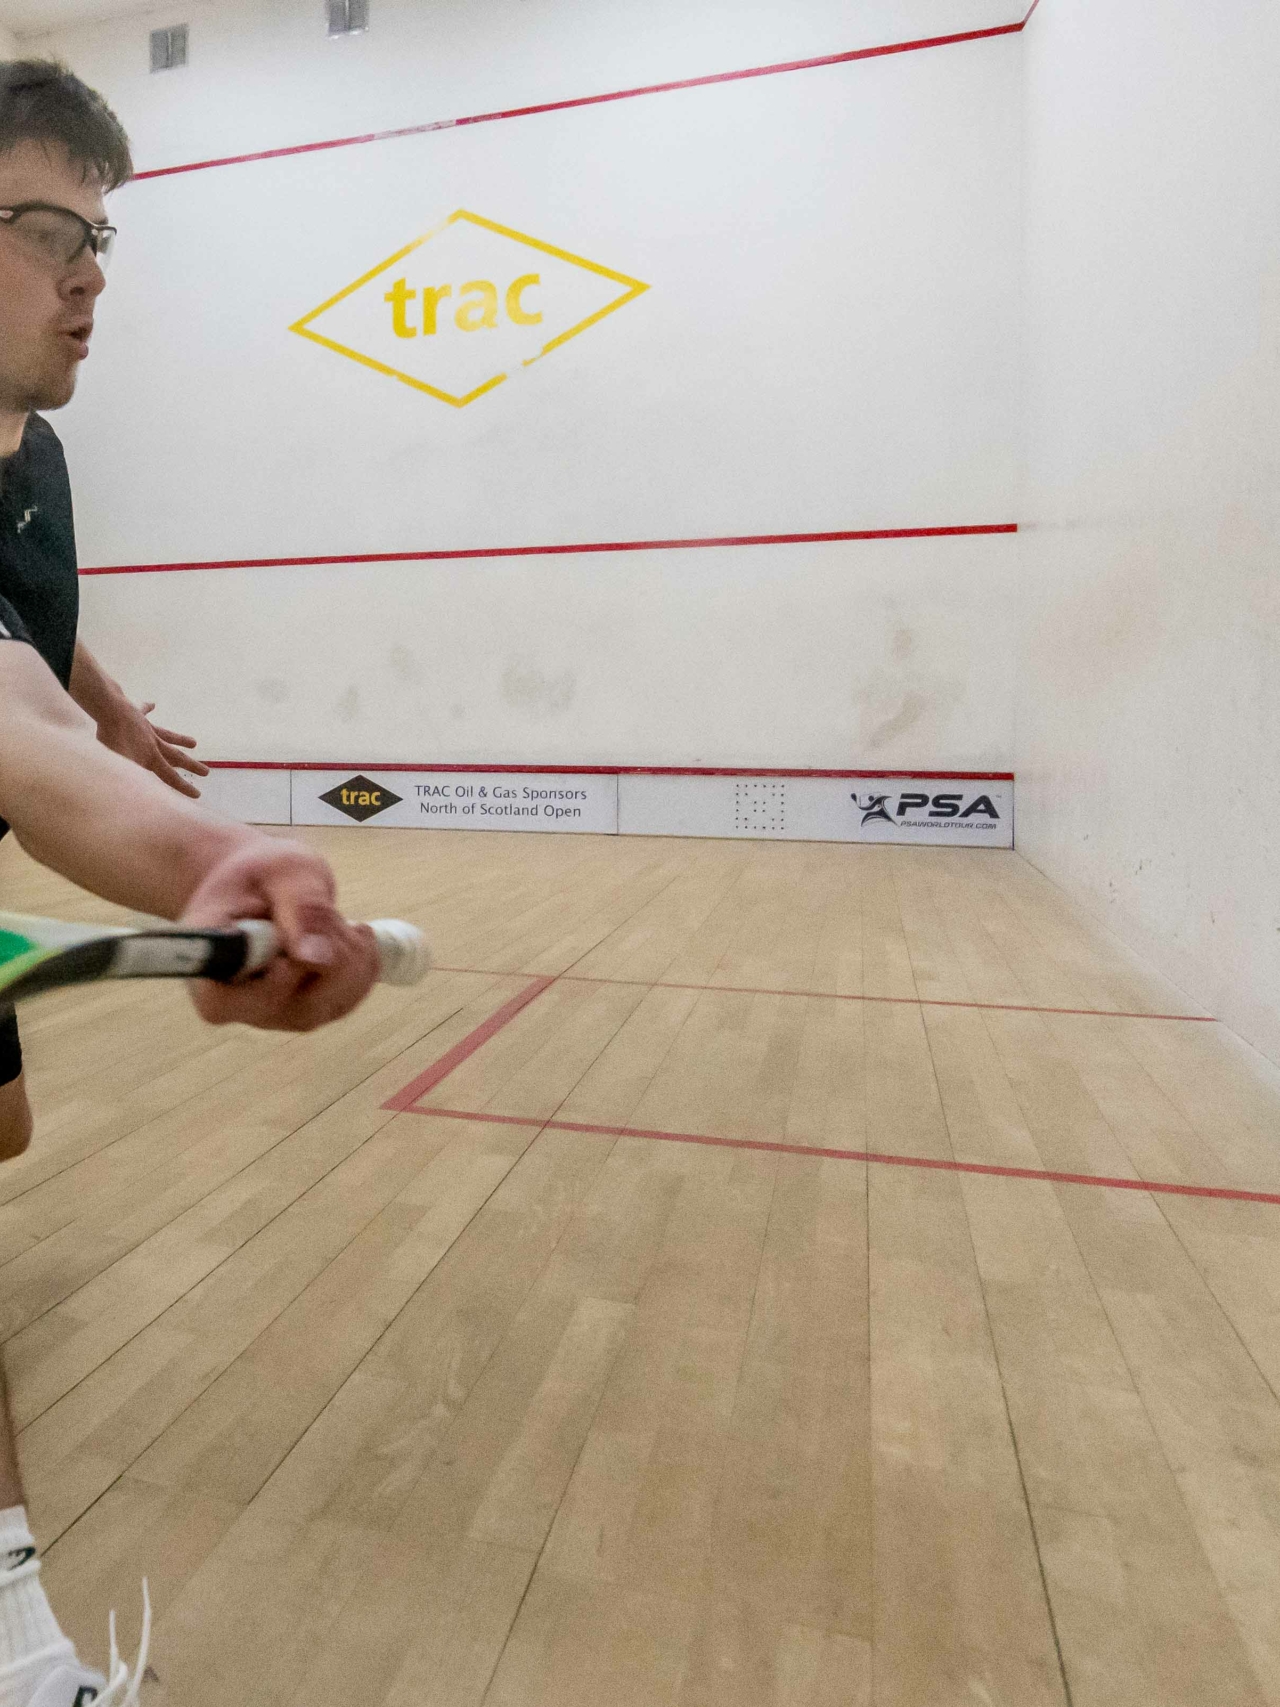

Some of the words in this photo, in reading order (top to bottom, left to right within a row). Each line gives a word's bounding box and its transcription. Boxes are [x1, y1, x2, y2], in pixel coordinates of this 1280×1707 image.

[384, 273, 544, 339] trac
[340, 788, 382, 806] trac
[414, 785, 451, 798] TRAC
[455, 785, 474, 798] Oil
[478, 786, 488, 798] &
[492, 786, 518, 799] Gas
[522, 787, 588, 801] Sponsors
[420, 802, 457, 815] North
[462, 803, 477, 815] of
[480, 803, 539, 817] Scotland
[543, 804, 582, 819] Open
[896, 793, 1001, 819] PSA
